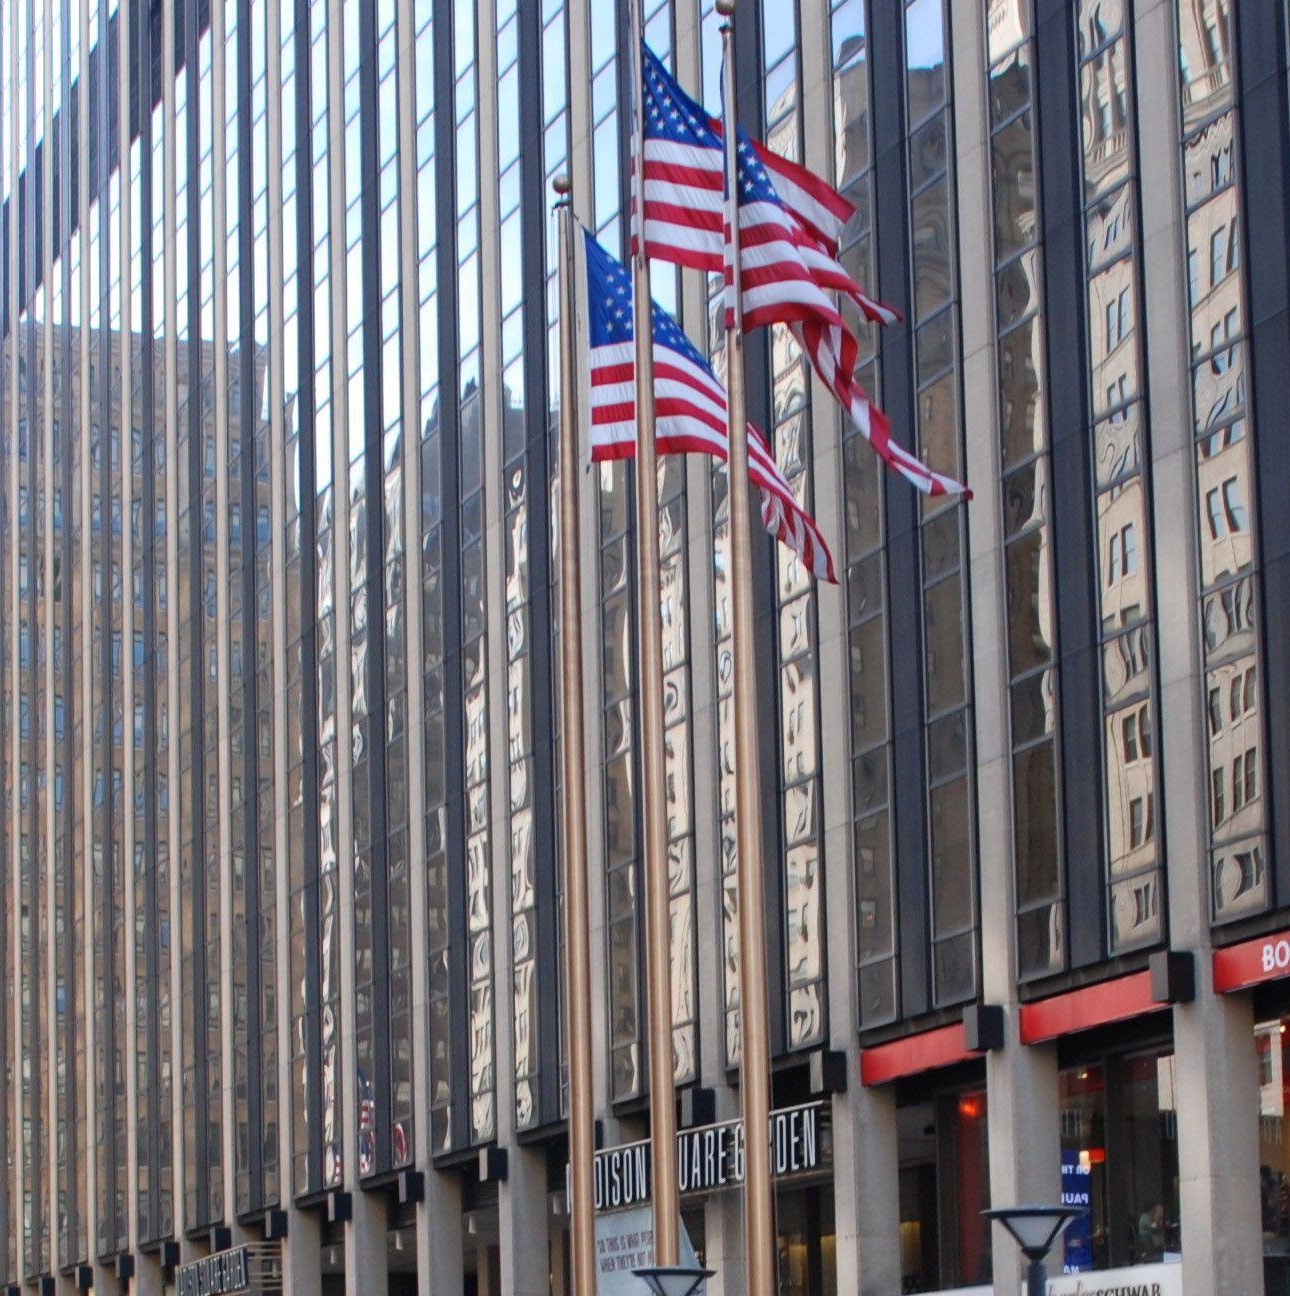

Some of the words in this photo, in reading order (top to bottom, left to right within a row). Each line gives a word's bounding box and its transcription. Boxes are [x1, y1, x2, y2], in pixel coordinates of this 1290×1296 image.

[566, 1145, 647, 1214] DISON
[678, 1130, 727, 1191] UARE
[734, 1107, 817, 1182] GDEN
